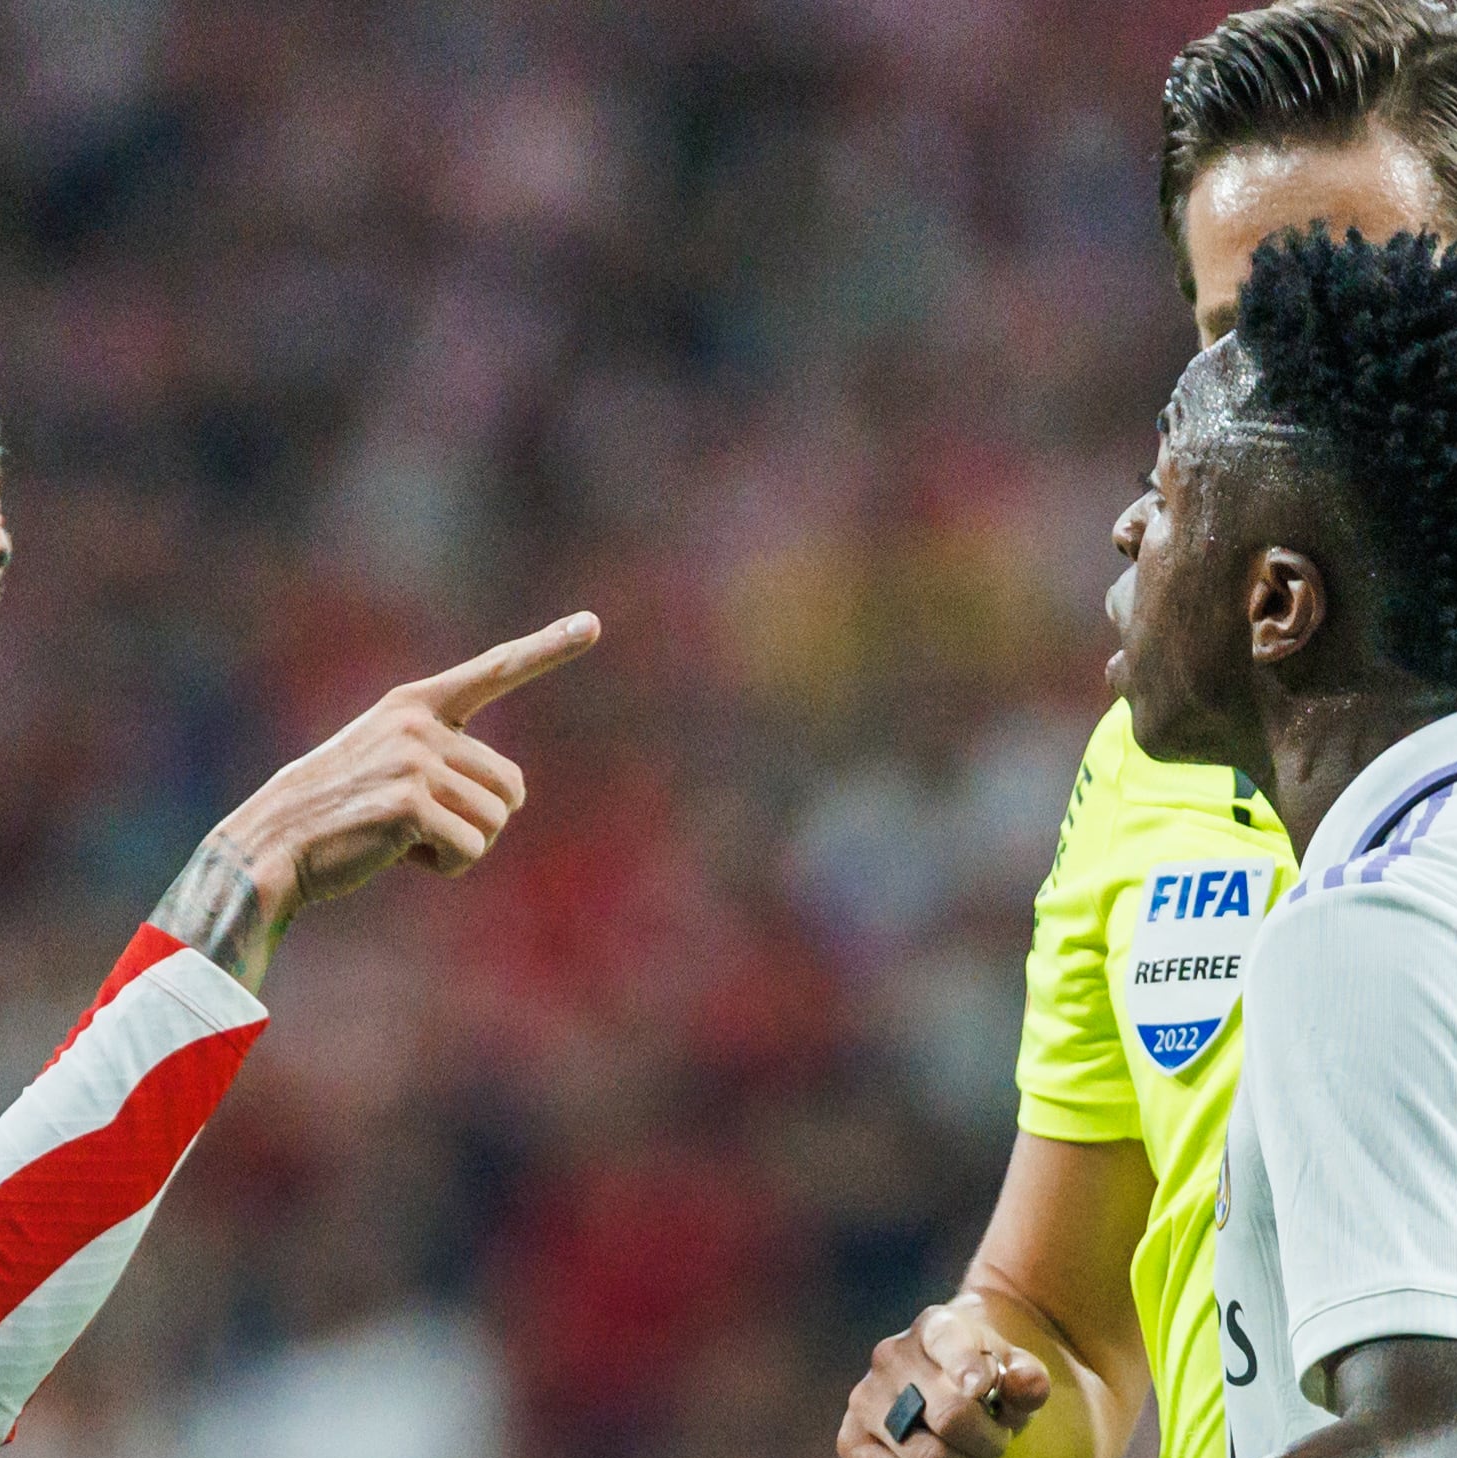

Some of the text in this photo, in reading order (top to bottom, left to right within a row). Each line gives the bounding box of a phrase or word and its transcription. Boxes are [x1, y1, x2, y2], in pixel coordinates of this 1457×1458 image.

[1147, 870, 1250, 923] FIFA
[1134, 955, 1242, 985] REFEREE
[1153, 1026, 1201, 1054] 2022
